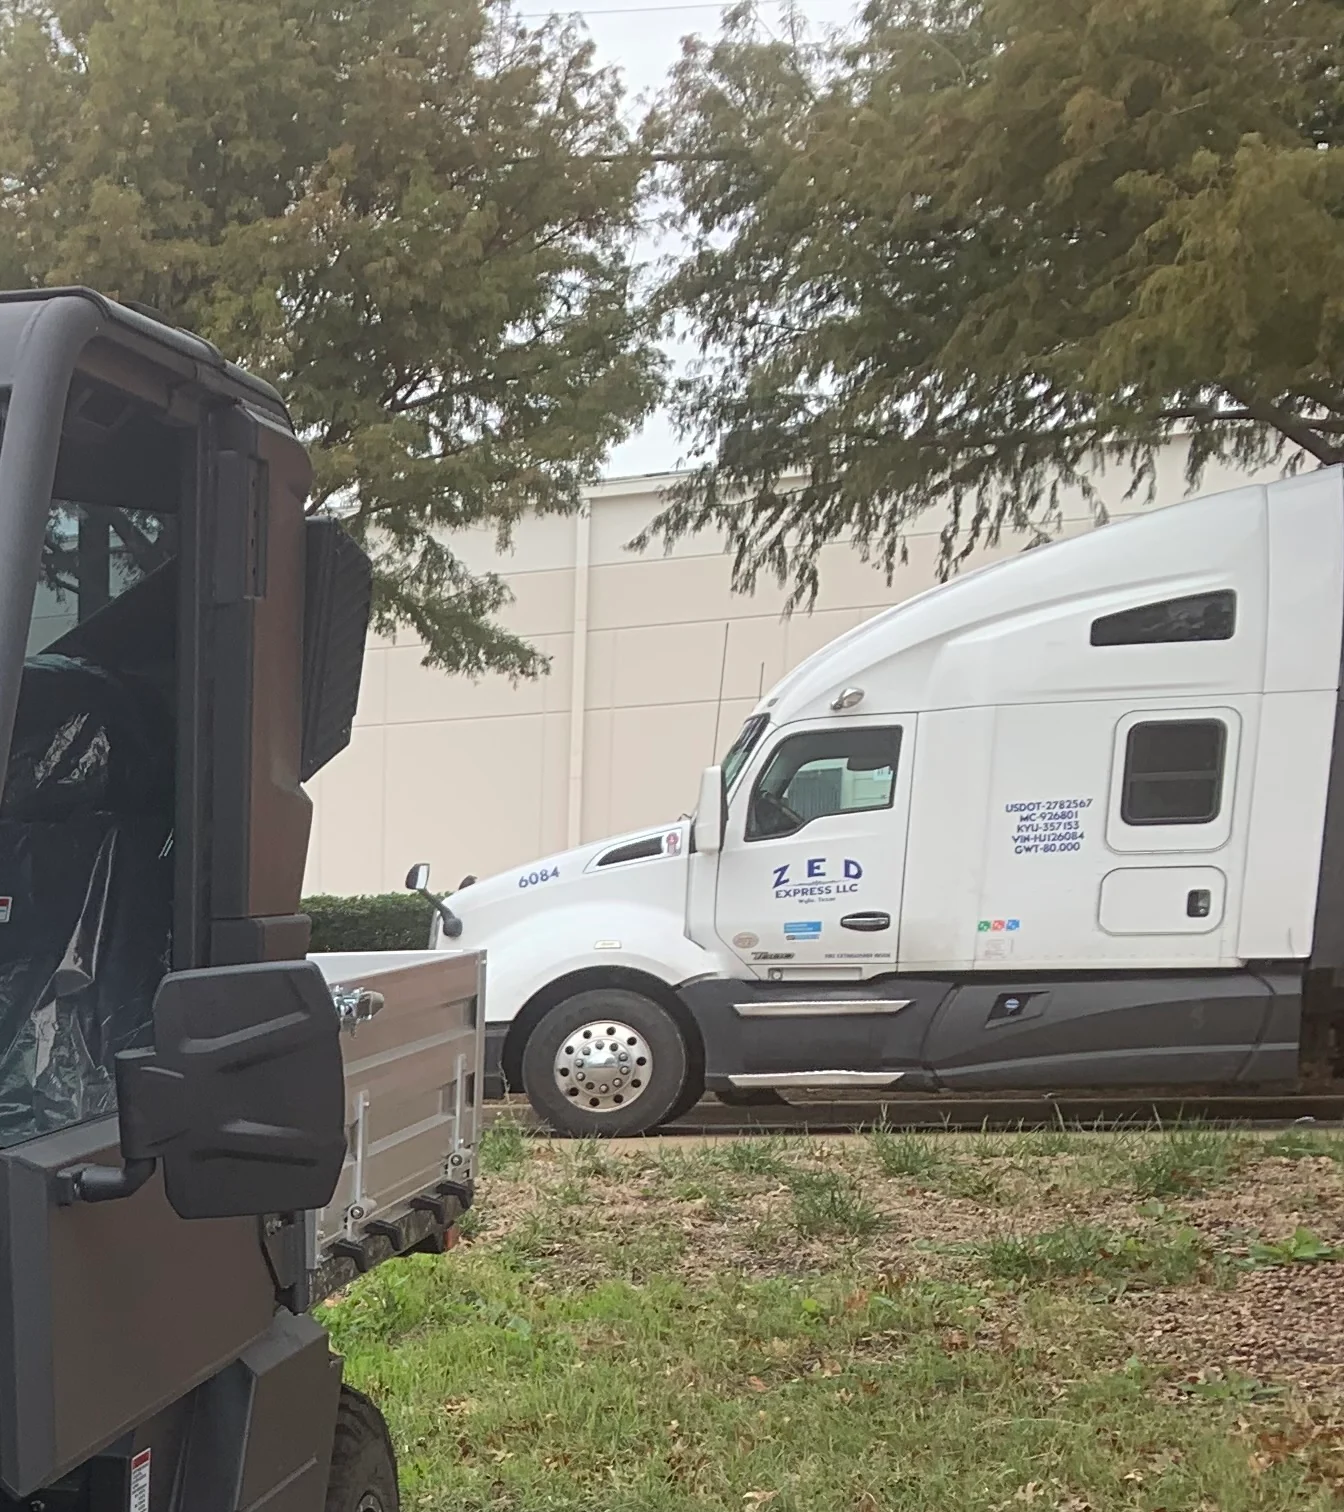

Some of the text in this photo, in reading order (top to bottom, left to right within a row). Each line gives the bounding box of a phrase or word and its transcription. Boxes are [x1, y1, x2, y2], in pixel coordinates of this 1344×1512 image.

[1005, 798, 1093, 813] USDOT-2782567
[1020, 810, 1078, 822] MC-926801
[1017, 820, 1080, 833] KYU-357153
[518, 866, 560, 888] 6084
[775, 883, 858, 899] EXPRESS LLC
